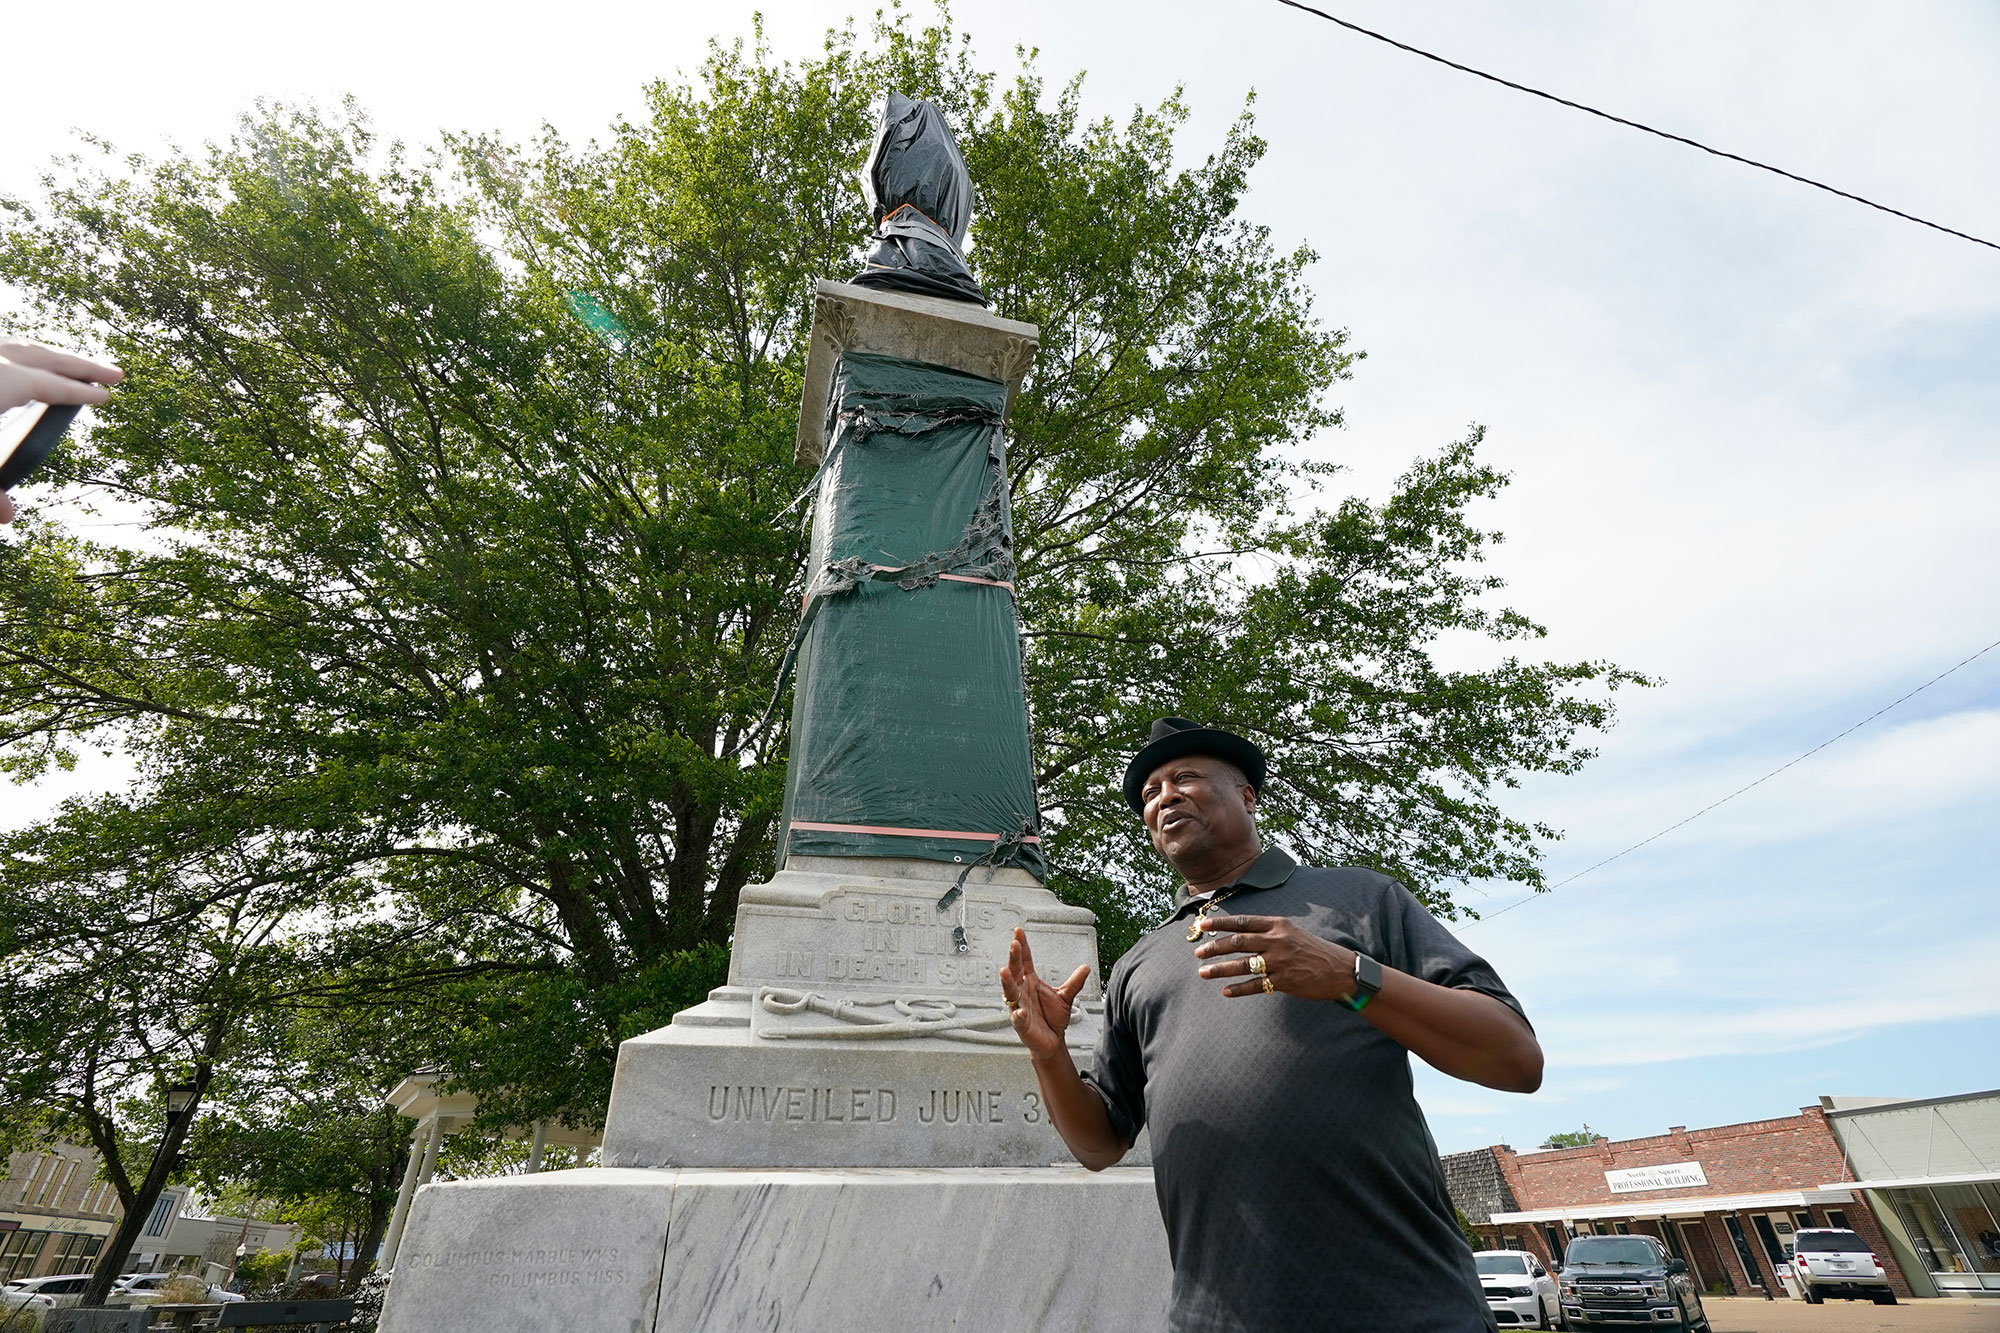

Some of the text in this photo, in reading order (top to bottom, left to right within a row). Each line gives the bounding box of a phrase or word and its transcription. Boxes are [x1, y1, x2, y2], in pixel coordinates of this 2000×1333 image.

[844, 897, 995, 929] GLORIOUS
[863, 926, 899, 953] IN
[777, 951, 812, 978] IN
[827, 954, 926, 984] DEATH
[709, 1085, 897, 1122] UNVEILED
[918, 1089, 1004, 1124] JUNE
[1612, 1174, 1702, 1191] PROFESSIONAL BUILDING
[408, 1249, 504, 1269] COLUMBUS
[489, 1271, 580, 1289] COLUMBUS
